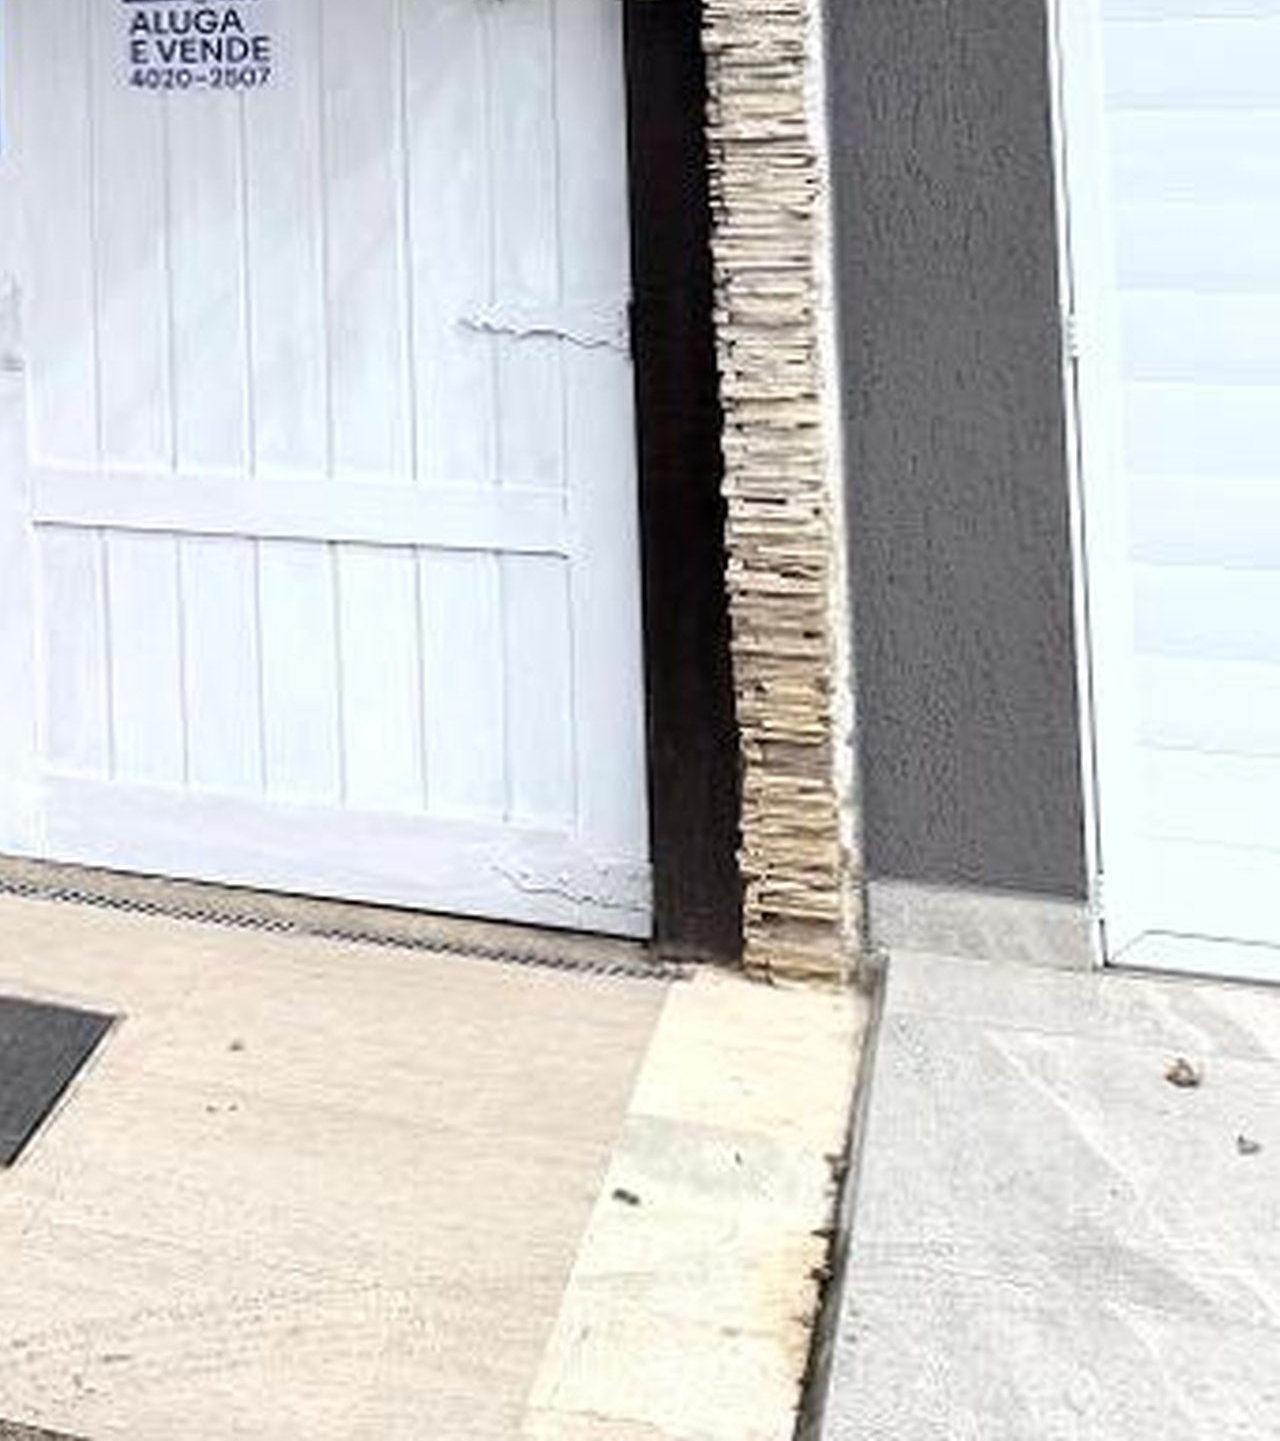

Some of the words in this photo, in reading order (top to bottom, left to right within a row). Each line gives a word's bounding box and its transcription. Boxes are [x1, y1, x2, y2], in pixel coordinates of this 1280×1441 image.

[130, 9, 245, 35] ALUGA
[130, 38, 148, 64] E
[156, 35, 272, 63] VENDE
[130, 67, 272, 90] 4020-2507
